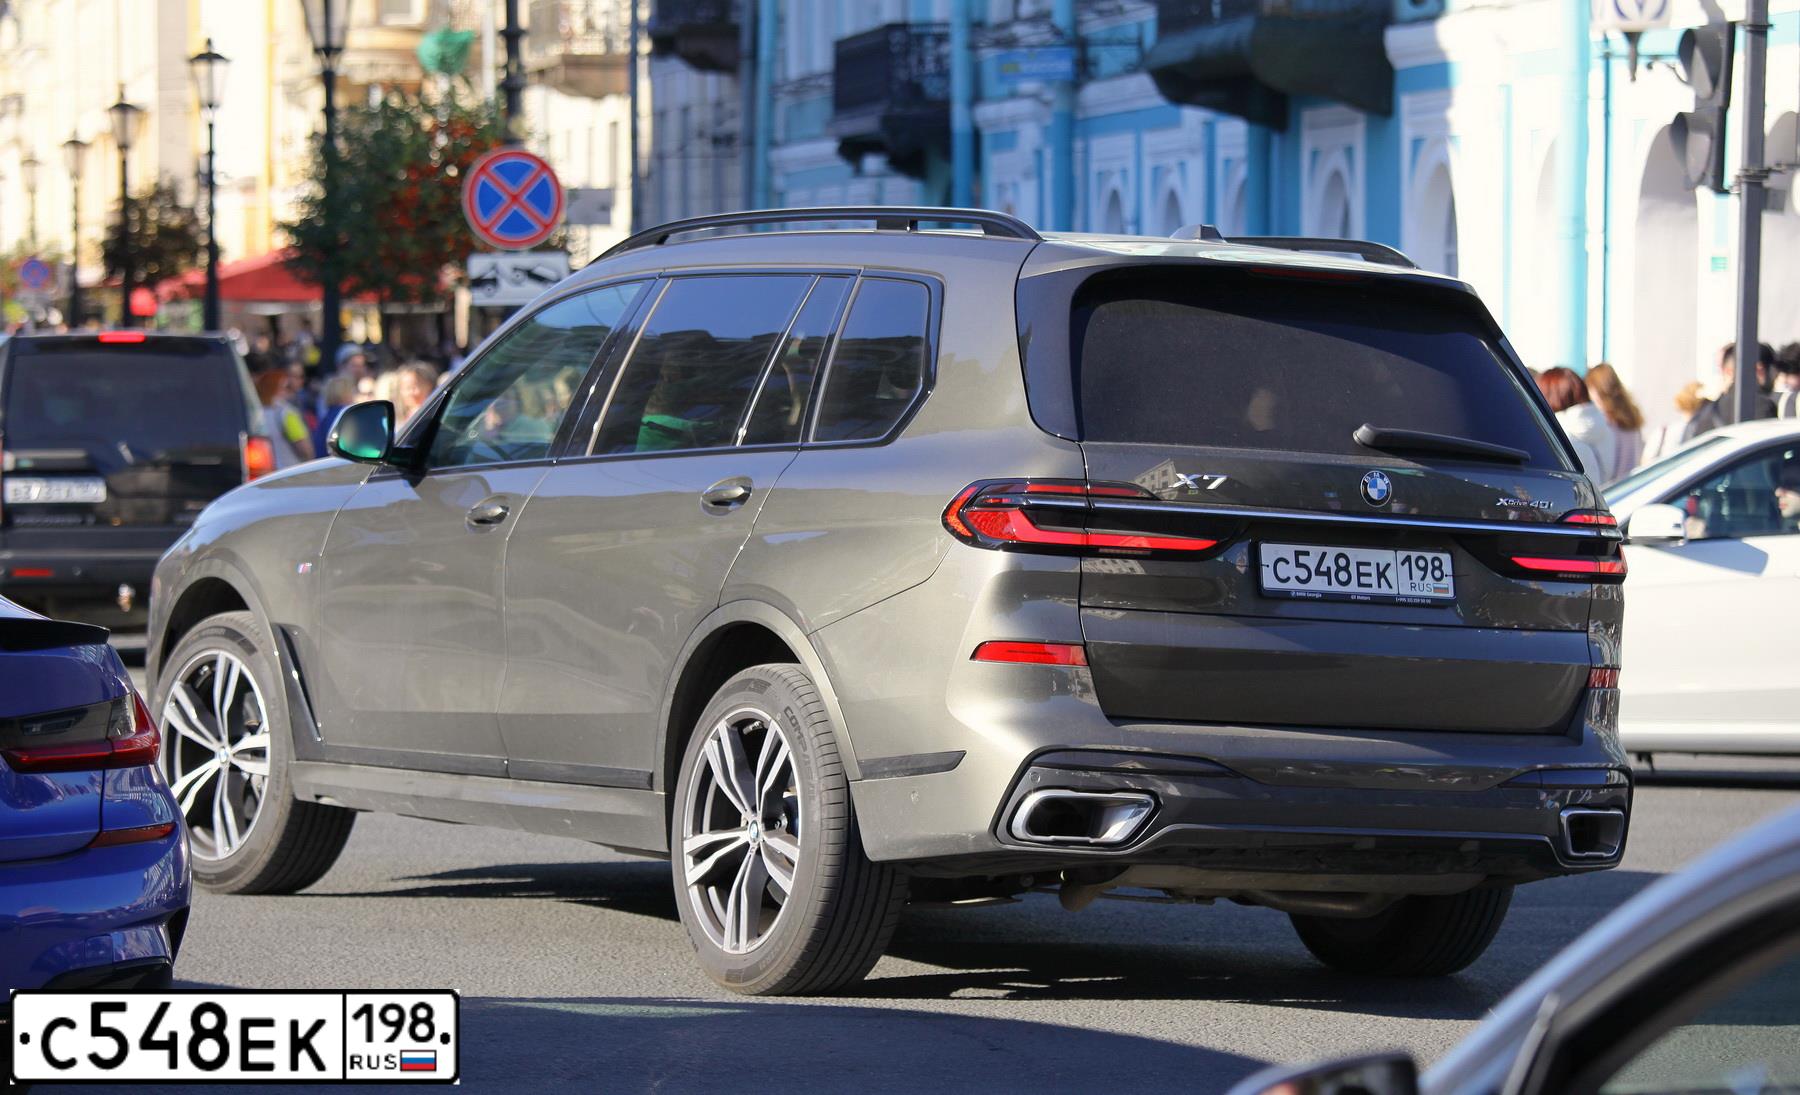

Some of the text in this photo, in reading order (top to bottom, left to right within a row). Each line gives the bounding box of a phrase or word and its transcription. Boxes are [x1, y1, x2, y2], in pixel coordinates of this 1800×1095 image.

[1168, 473, 1227, 490] X7
[1401, 554, 1444, 582] 198
[1410, 582, 1433, 593] RUS
